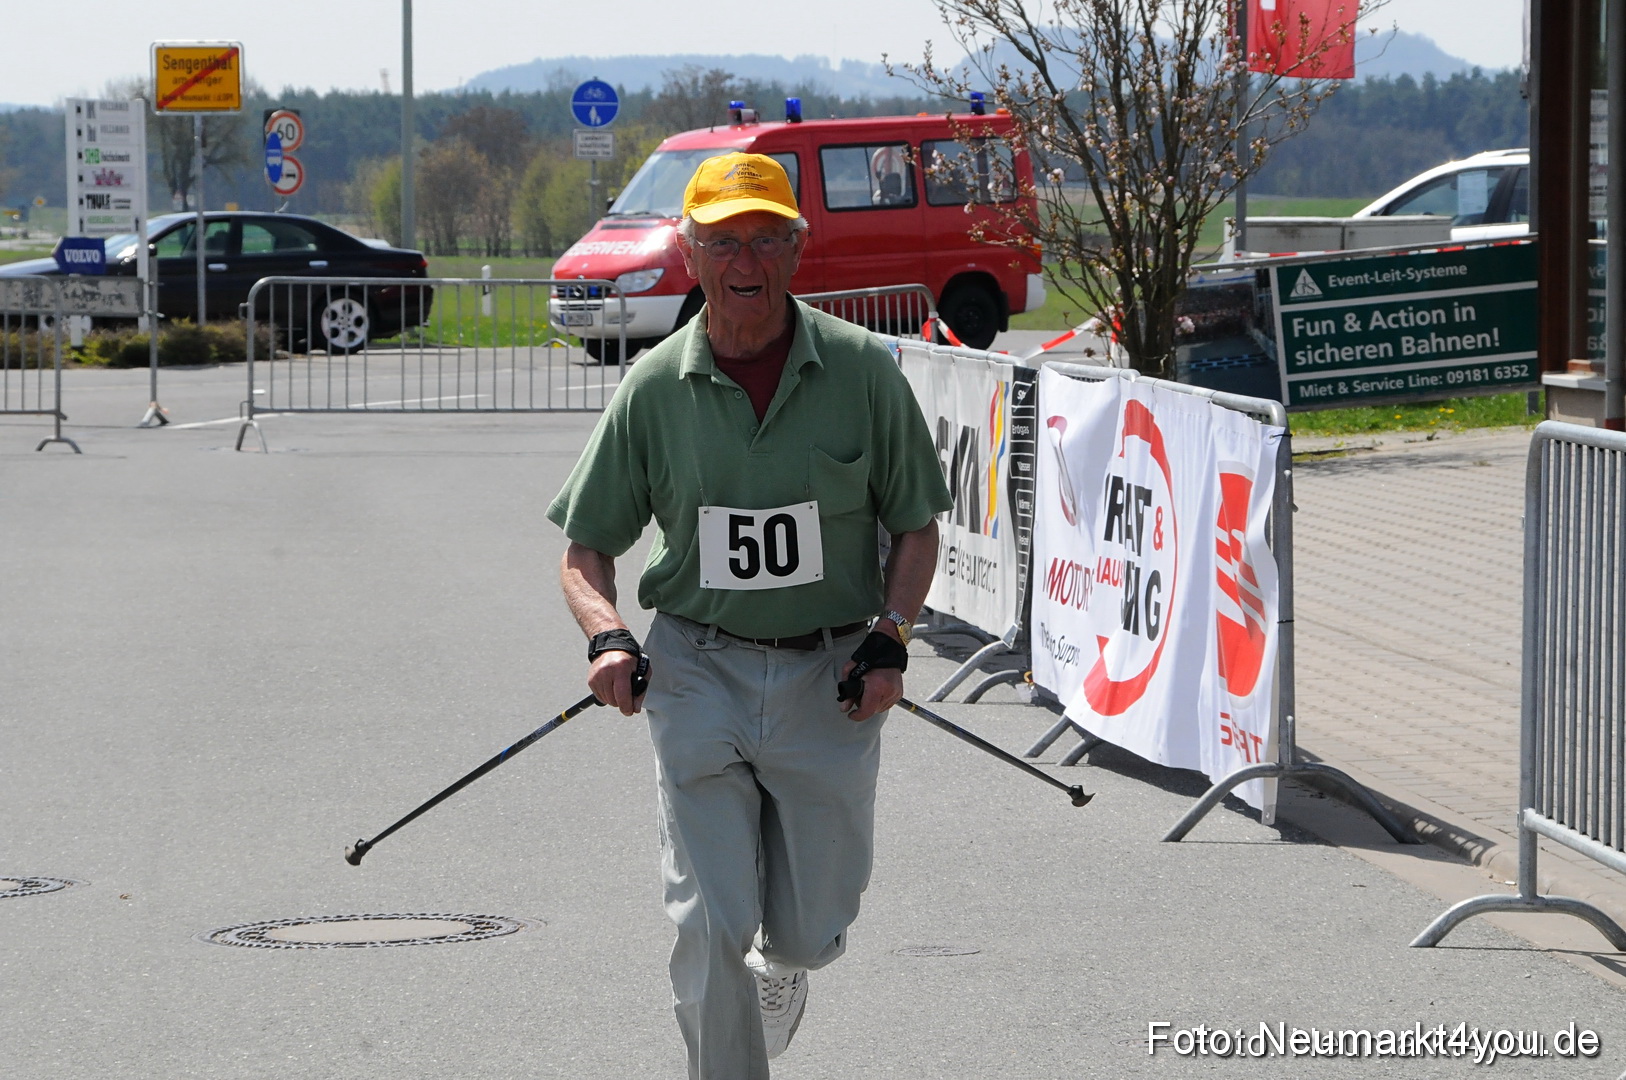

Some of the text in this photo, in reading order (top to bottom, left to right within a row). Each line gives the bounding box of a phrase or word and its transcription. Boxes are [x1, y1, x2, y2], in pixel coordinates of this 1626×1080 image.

[277, 123, 295, 142] 60
[63, 249, 101, 263] VOLVO
[1328, 264, 1468, 287] Event-Leit-Systeme
[1292, 301, 1476, 338] Fun & Action in
[1295, 327, 1500, 366] sicheren Bahnen!
[1300, 364, 1530, 398] Miet & Service Line: 09181 6352
[1153, 505, 1164, 551] &
[728, 513, 800, 580] 50
